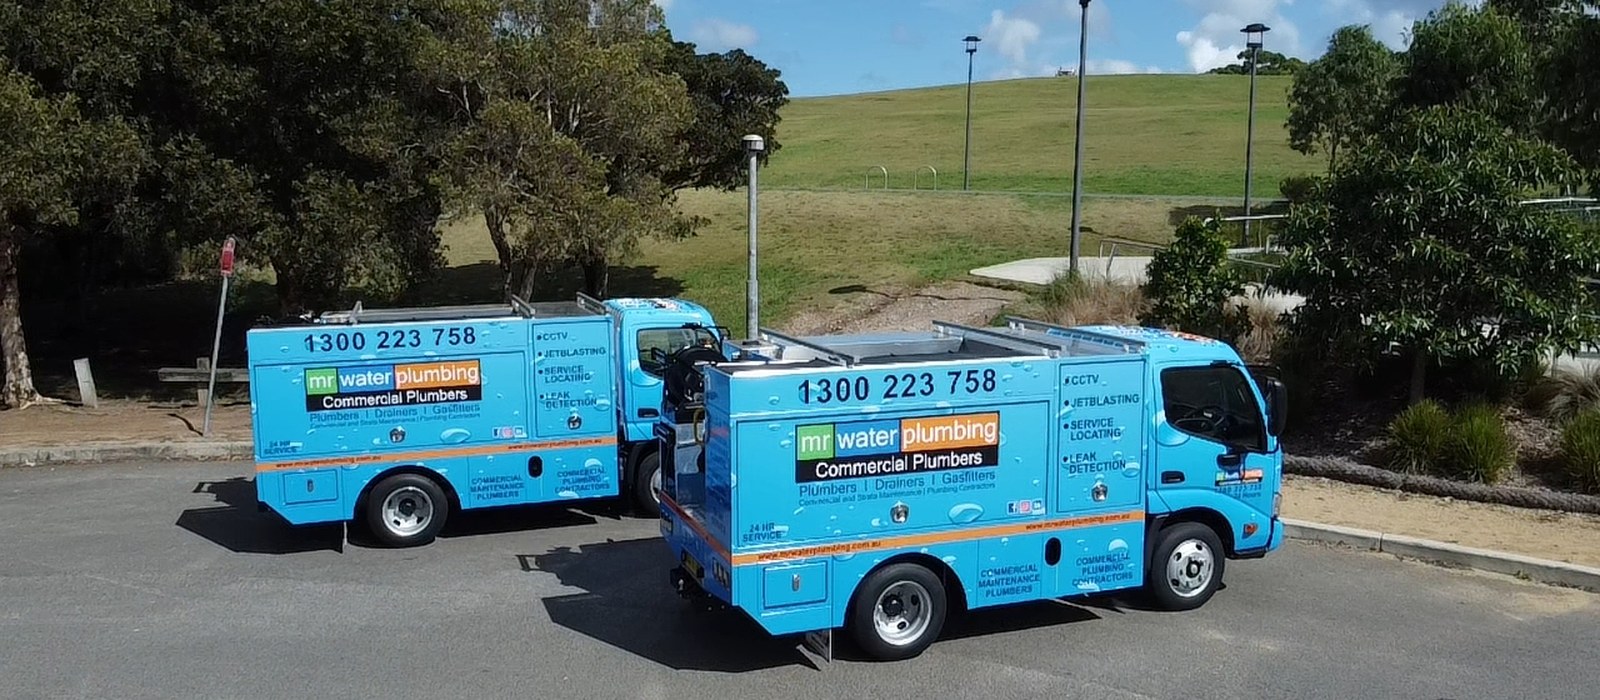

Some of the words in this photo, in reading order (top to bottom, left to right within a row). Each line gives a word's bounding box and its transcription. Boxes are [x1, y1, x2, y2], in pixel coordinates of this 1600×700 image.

[304, 332, 365, 352] 1300
[377, 329, 421, 349] 223
[432, 326, 476, 346] 758
[543, 332, 568, 341] CCTV
[544, 347, 606, 358] JETBLASTING
[309, 373, 335, 388] mr
[339, 370, 392, 387] water
[396, 364, 479, 385] plumbing
[544, 365, 584, 375] SERVICE
[545, 373, 591, 384] LOCATING
[1071, 374, 1099, 385] CCTV
[798, 376, 869, 404] 1300
[883, 373, 934, 399] 223
[947, 369, 996, 394] 758
[323, 392, 402, 408] Commercial
[406, 389, 467, 404] Plumbers
[545, 392, 570, 400] LEAK
[1071, 394, 1139, 407] JETBLASTING
[546, 398, 597, 409] DETECTION
[310, 411, 359, 422] Plumbers
[375, 408, 417, 418] Drainers
[1070, 417, 1114, 430] SERVICE
[801, 433, 831, 452] mr
[837, 427, 898, 449] water
[903, 420, 997, 447] plumbing
[1070, 428, 1121, 440] LOCATING
[1069, 452, 1096, 463] LEAK
[815, 456, 908, 478] Commercial
[913, 452, 983, 470] Plumbers
[1069, 460, 1126, 474] DETECTION
[471, 474, 522, 484] COMMERCIAL
[800, 483, 857, 497] Plumbers
[875, 477, 925, 490] Drainers
[942, 470, 995, 484] Gasfitters
[470, 482, 524, 493] MAINTENANCE
[555, 483, 610, 494] CONTRACTORS
[476, 490, 519, 501] PLUMBERS
[750, 524, 760, 532] 24
[762, 522, 774, 531] HR
[743, 531, 782, 542] SERVICE
[1076, 552, 1130, 566] COMMERCIAL
[980, 563, 1038, 578] COMMERCIAL
[1082, 563, 1124, 575] PLUMBING
[978, 574, 1040, 587] MAINTENANCE
[1072, 572, 1133, 587] CONTRACTORS
[985, 585, 1033, 597] PLUMBERS
